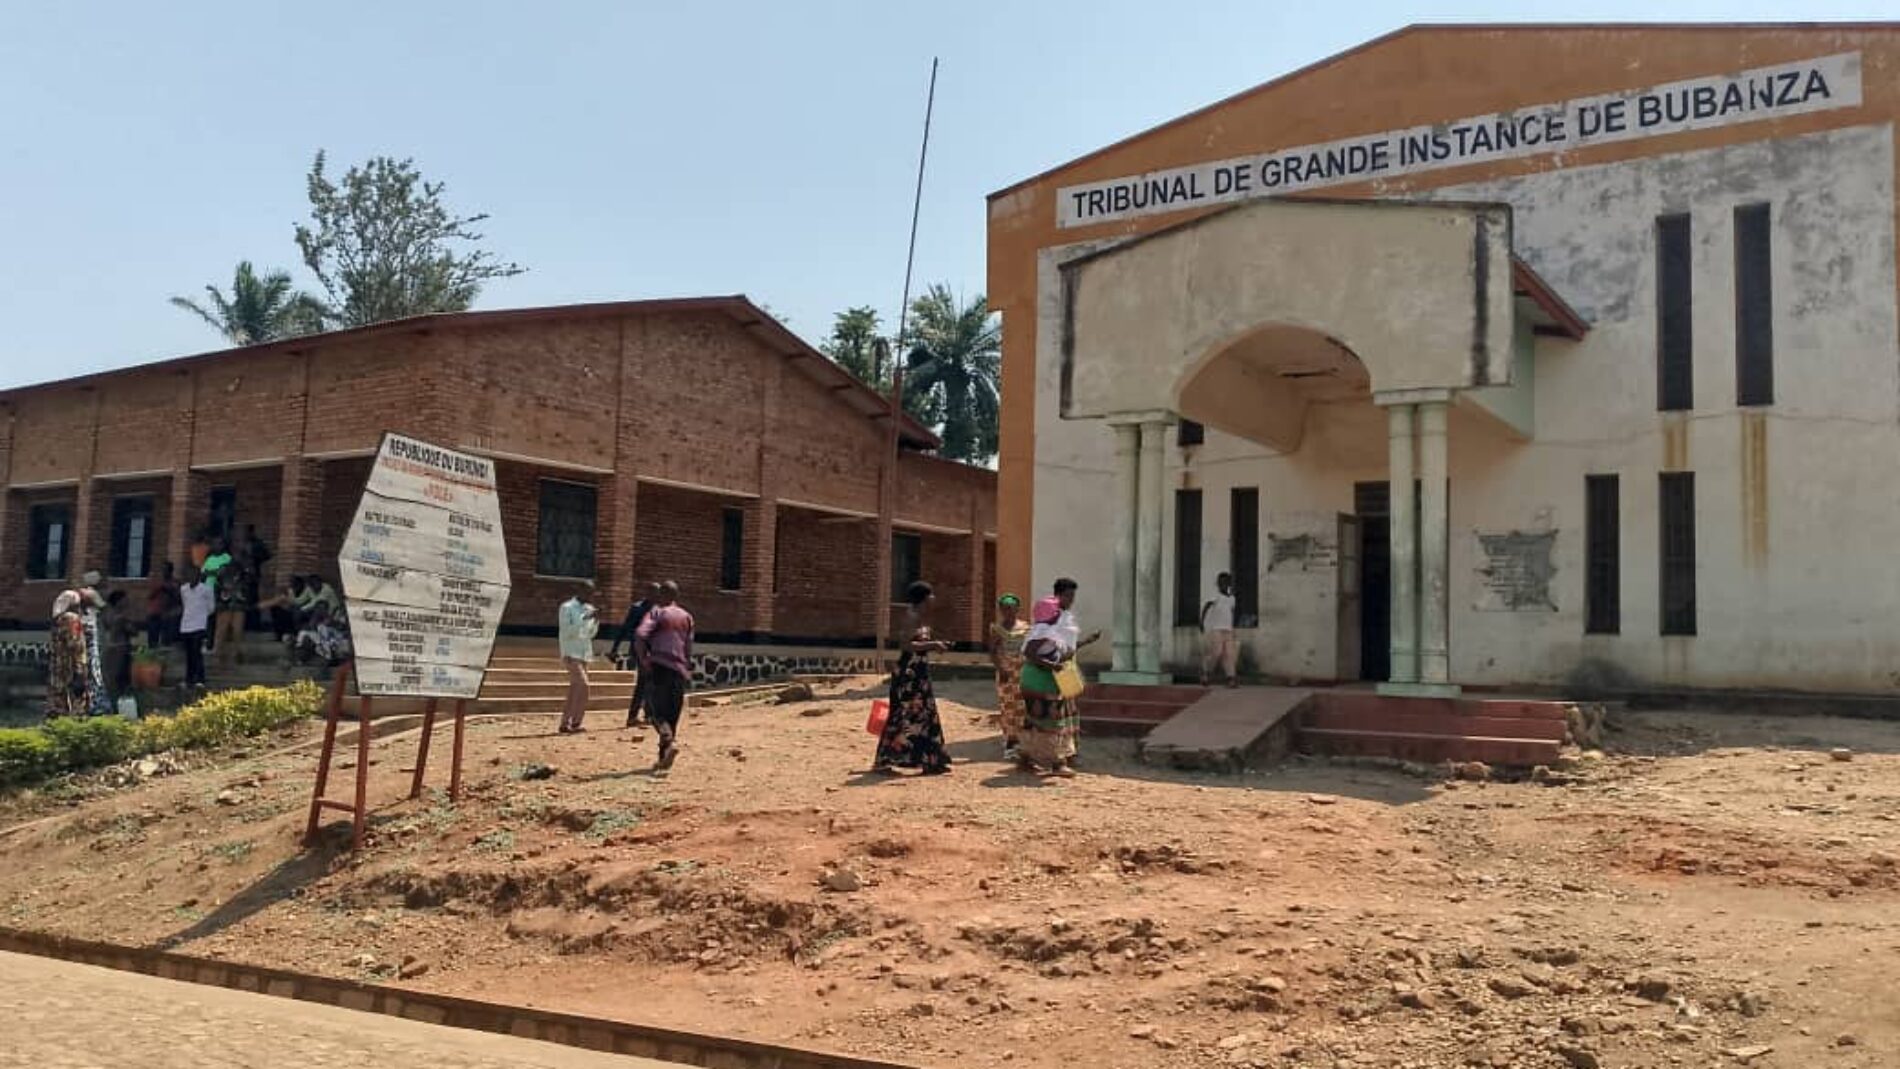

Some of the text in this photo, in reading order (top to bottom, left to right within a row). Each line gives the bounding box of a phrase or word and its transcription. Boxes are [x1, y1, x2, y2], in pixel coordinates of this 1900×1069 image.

[1072, 69, 1830, 218] TRIBUNAL DE GRANDE INSTANCE DE BUBANZA
[390, 438, 441, 467] REPUBLIQUE
[441, 451, 454, 470] DU
[454, 455, 489, 479] BURUNDI
